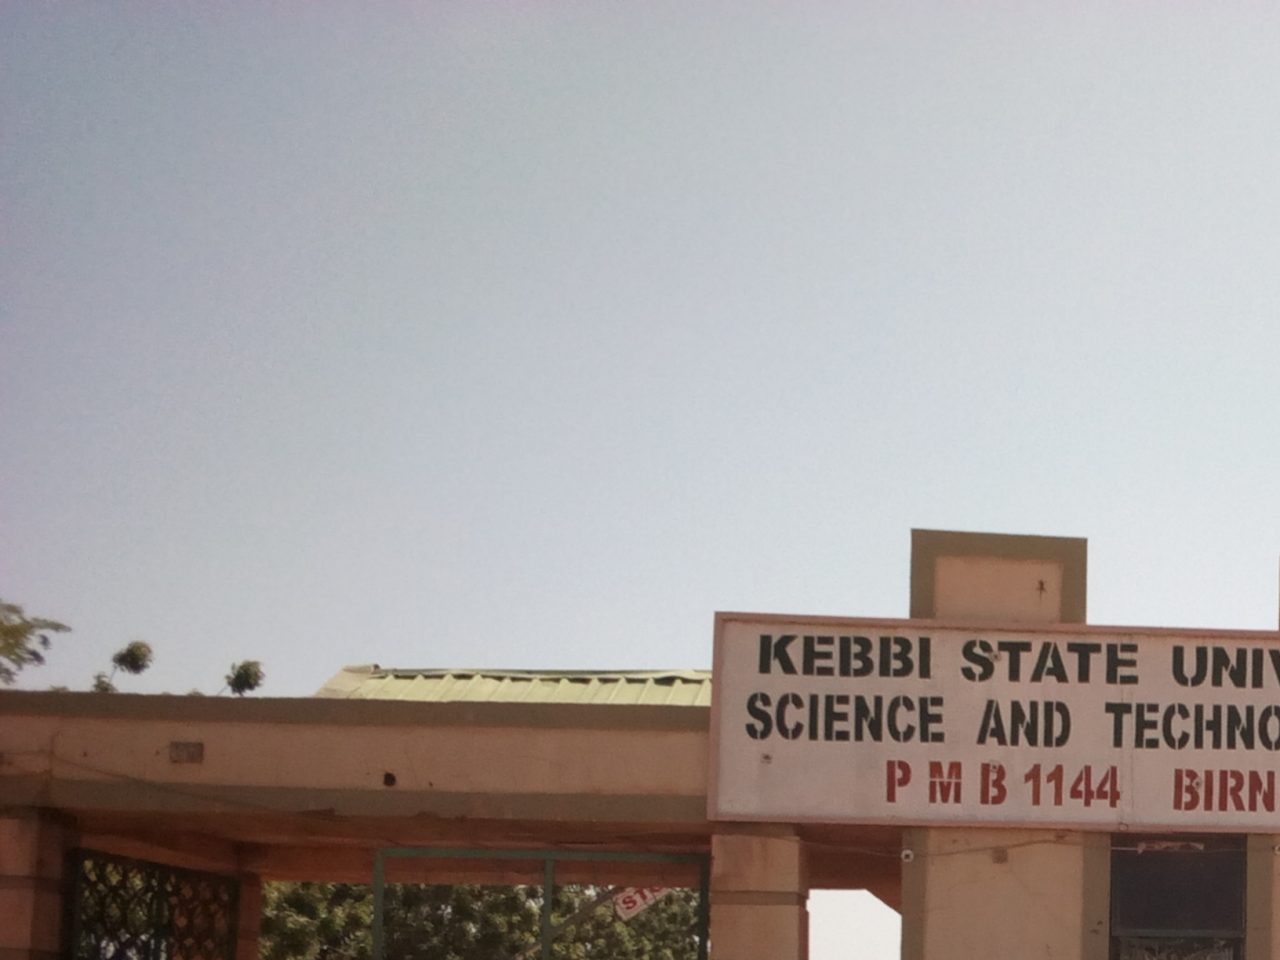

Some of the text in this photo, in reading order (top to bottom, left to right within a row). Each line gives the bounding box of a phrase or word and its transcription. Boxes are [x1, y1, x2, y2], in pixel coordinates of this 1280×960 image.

[759, 634, 930, 678] KEBBI
[962, 639, 1138, 684] STATE
[746, 693, 944, 742] SCIENCE
[977, 700, 1070, 747] AND
[887, 760, 911, 802] P
[929, 761, 961, 803] M
[981, 763, 1006, 804] B
[1025, 764, 1120, 808] 1144
